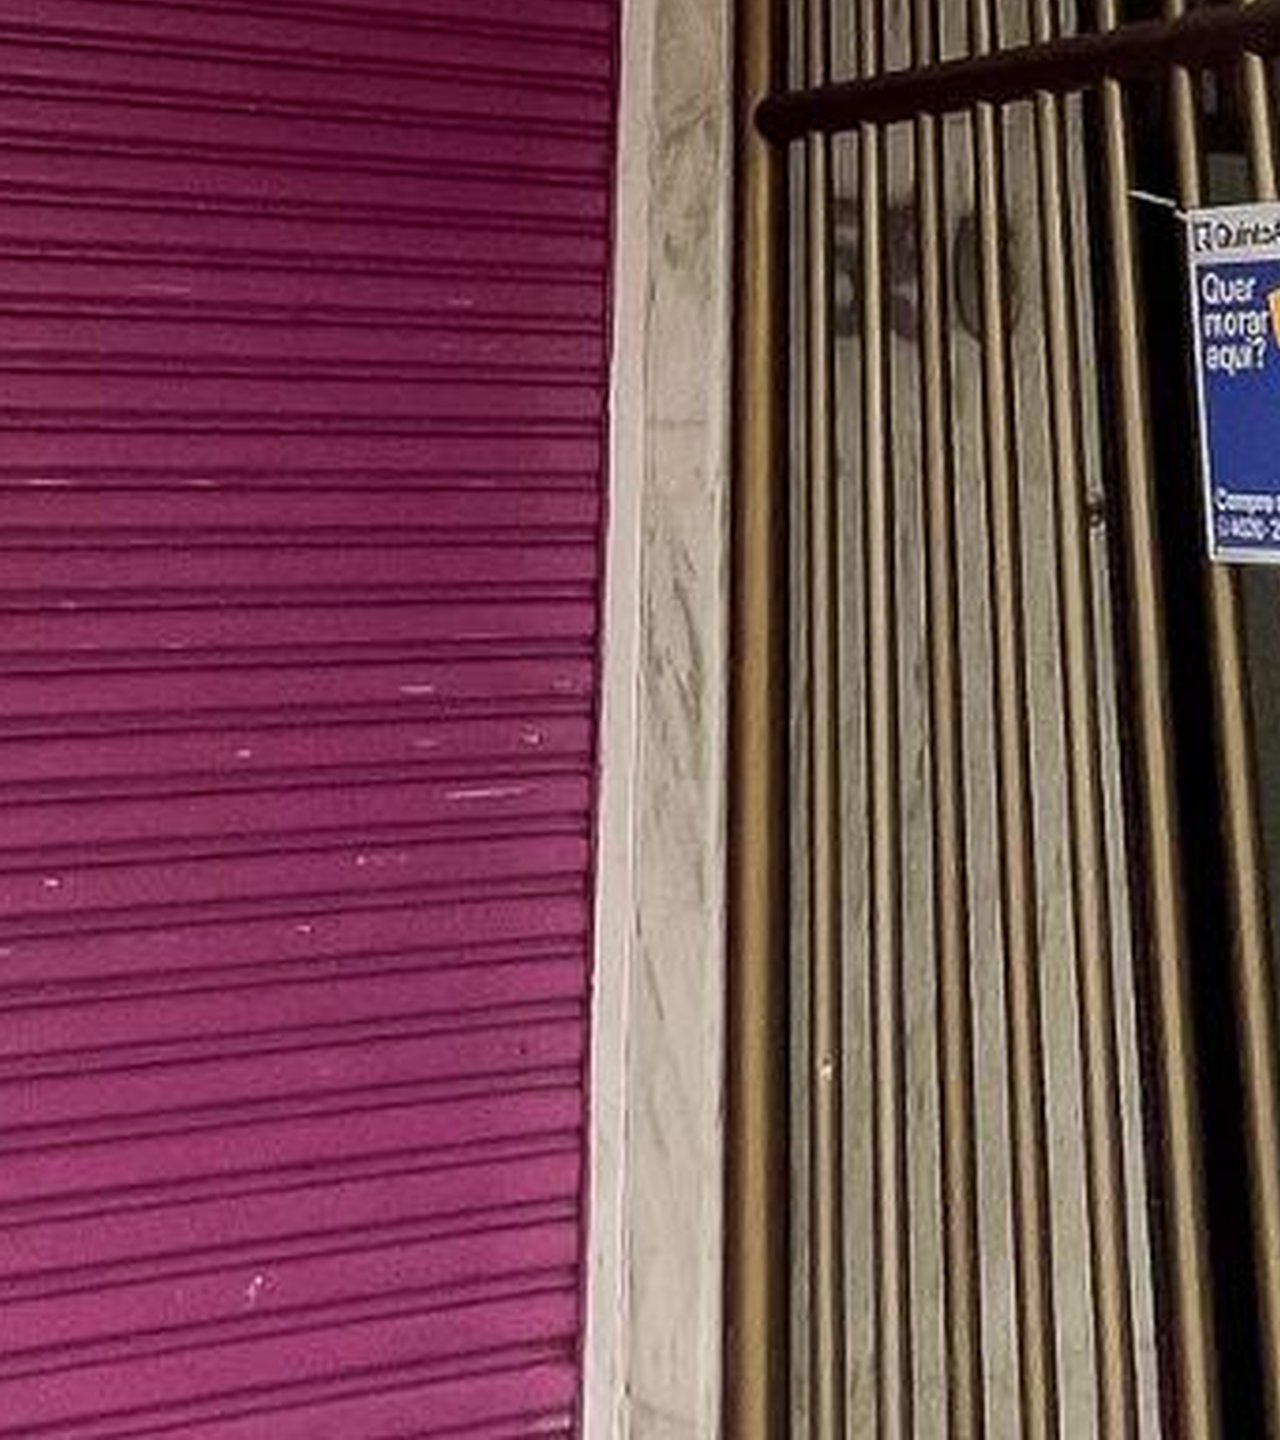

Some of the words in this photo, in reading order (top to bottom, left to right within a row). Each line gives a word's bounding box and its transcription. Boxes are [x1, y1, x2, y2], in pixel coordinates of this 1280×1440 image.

[1202, 272, 1256, 305] Quer
[1204, 310, 1269, 338] morar
[1206, 337, 1267, 376] aqui?
